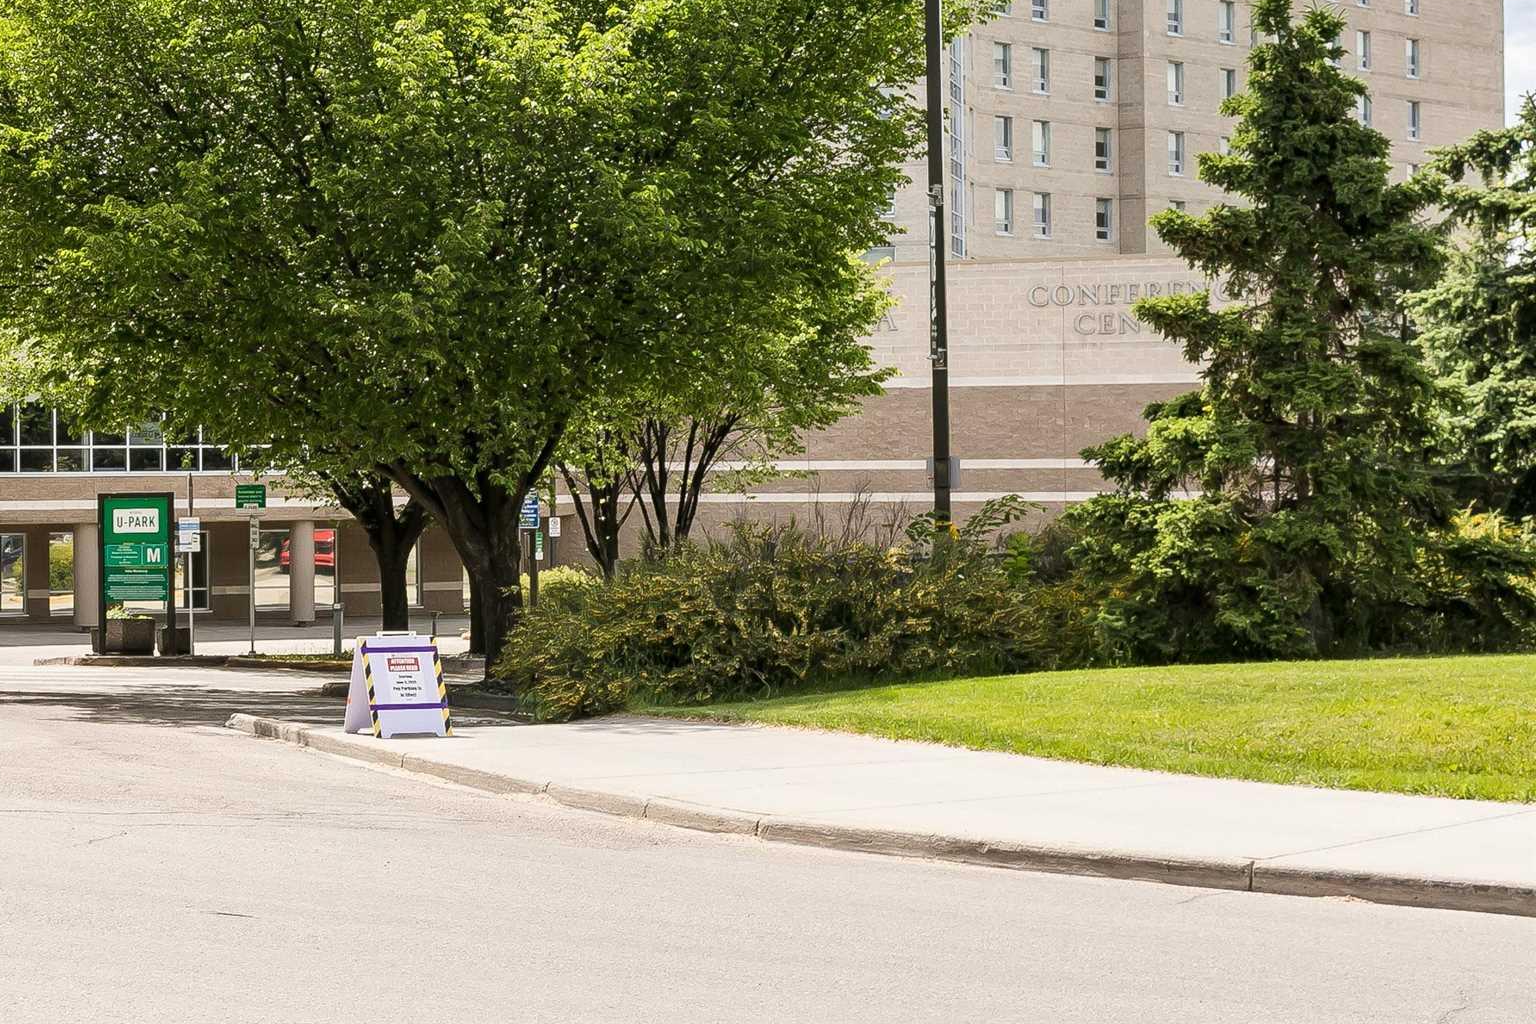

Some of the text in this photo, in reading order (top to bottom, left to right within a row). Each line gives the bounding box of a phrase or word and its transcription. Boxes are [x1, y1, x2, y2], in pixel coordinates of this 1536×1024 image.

[1028, 280, 1254, 307] CONFERENC
[116, 516, 156, 528] U-PARK
[146, 547, 161, 563] M
